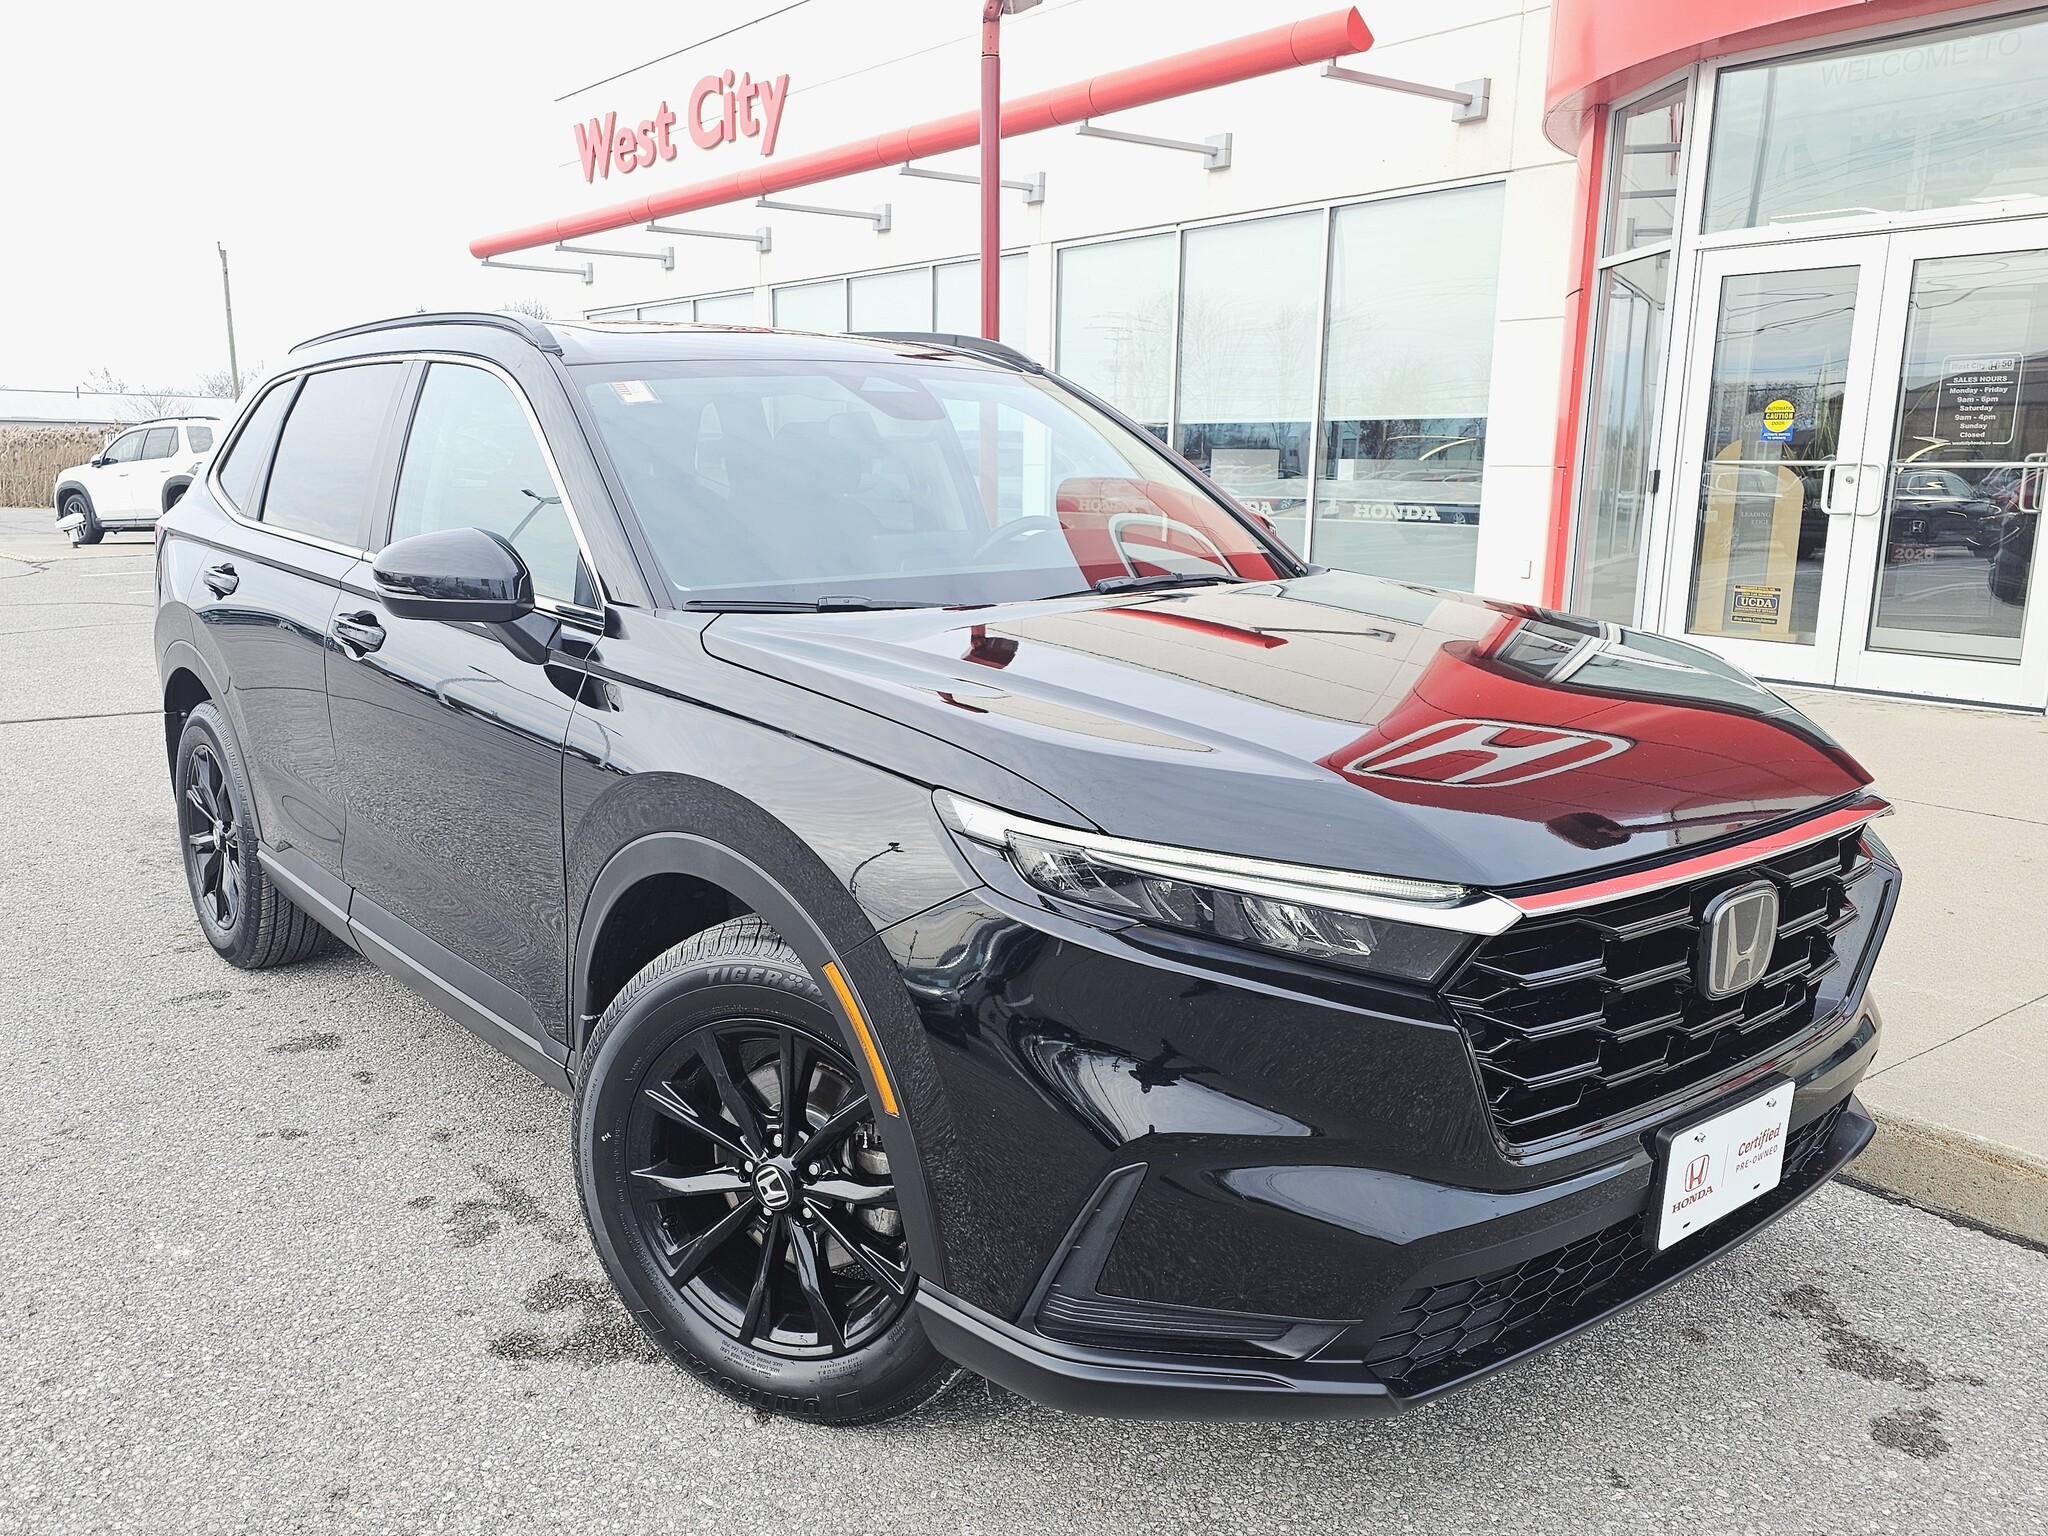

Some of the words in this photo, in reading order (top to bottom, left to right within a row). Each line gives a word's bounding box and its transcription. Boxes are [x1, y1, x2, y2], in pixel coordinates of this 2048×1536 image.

[1821, 42, 1969, 88] WELCOME
[1985, 31, 2022, 59] TO
[574, 101, 677, 183] West
[688, 69, 790, 157] City
[1353, 504, 1440, 520] HONDA
[1894, 548, 1935, 560] 2026
[1741, 598, 1772, 608] UCDA
[706, 966, 783, 990] TIGER
[1738, 1122, 1781, 1156] Certified
[1736, 1144, 1778, 1173] PRE-OWNED
[1672, 1186, 1714, 1214] HONDA
[672, 1339, 823, 1418] UNIROYAL
